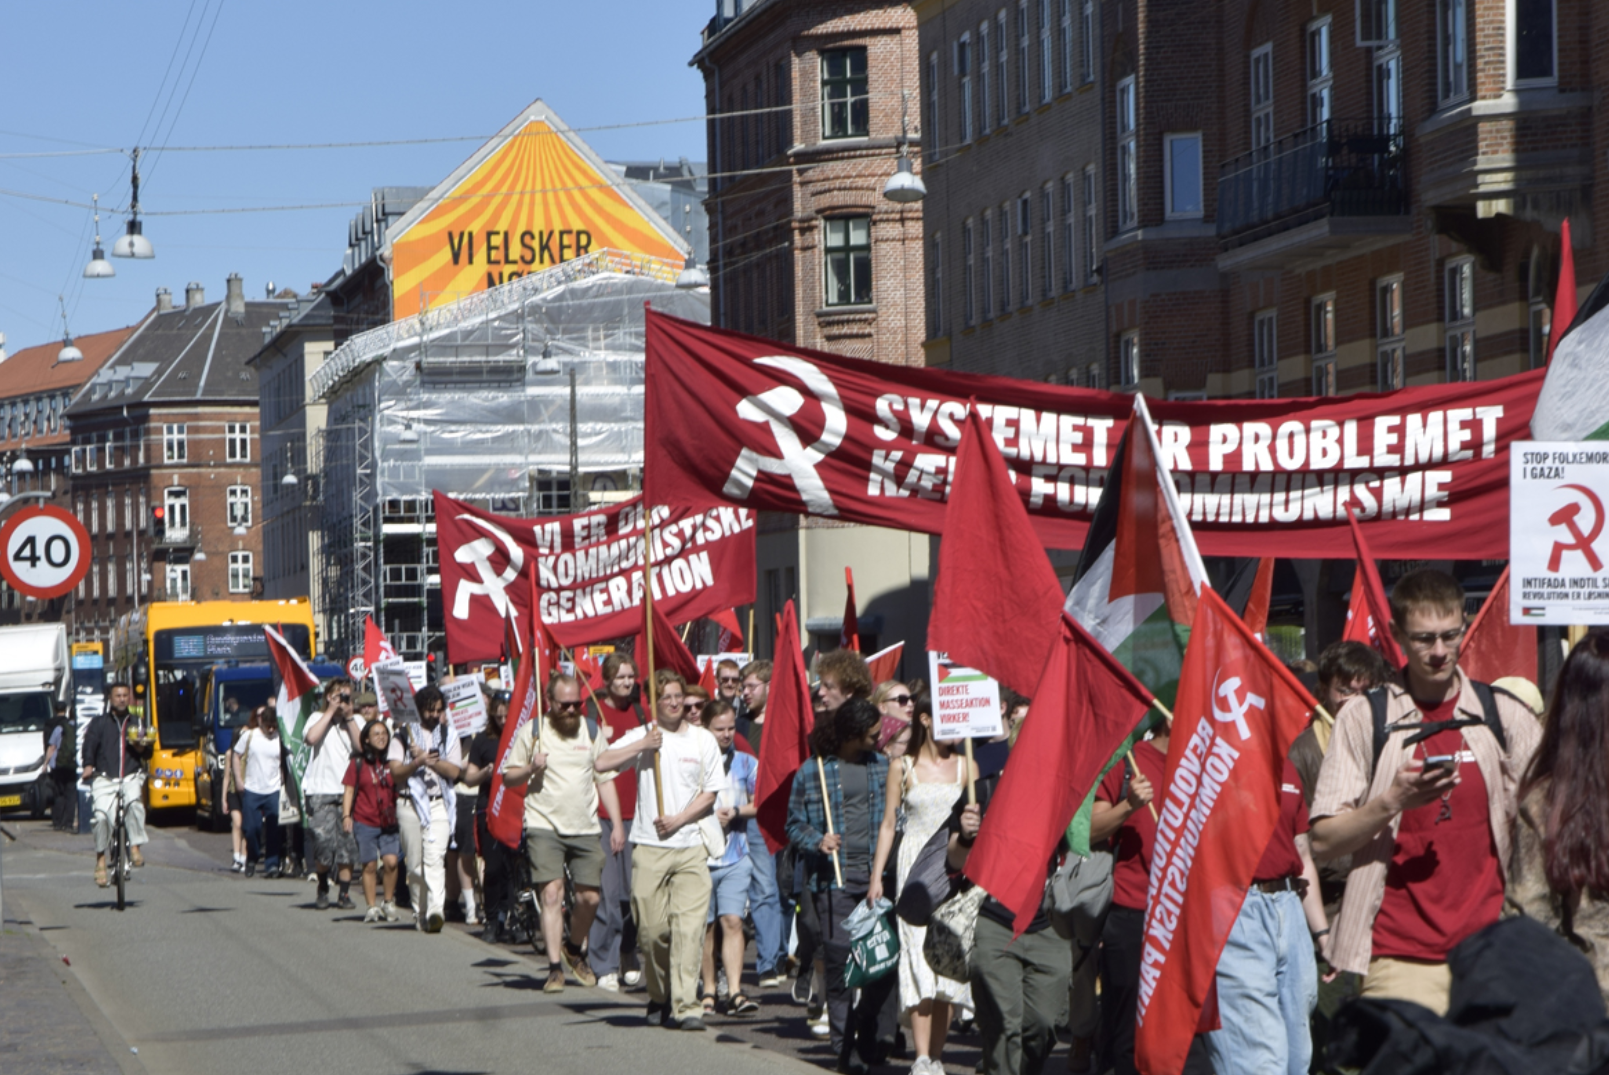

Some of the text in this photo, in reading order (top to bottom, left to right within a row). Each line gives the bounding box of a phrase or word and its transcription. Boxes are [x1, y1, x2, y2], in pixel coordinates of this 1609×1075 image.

[448, 229, 592, 265] VI ELSKER
[1153, 420, 1193, 471] R
[1209, 405, 1504, 472] PROBLEMET
[1523, 451, 1550, 465] STOP
[1523, 466, 1565, 479] I GAZA!
[1170, 471, 1453, 524] OMMUNISME
[533, 520, 561, 555] VI
[573, 513, 607, 549] ER
[13, 534, 72, 568] 40
[539, 550, 715, 625] GENERATION
[1522, 577, 1566, 589] INTIFADA
[1569, 577, 1600, 589] INDTIL
[1522, 591, 1569, 601] REVOLUTION
[1571, 591, 1582, 601] ER
[938, 684, 970, 697] DIREKTE
[938, 697, 991, 711] MASSEAKTION
